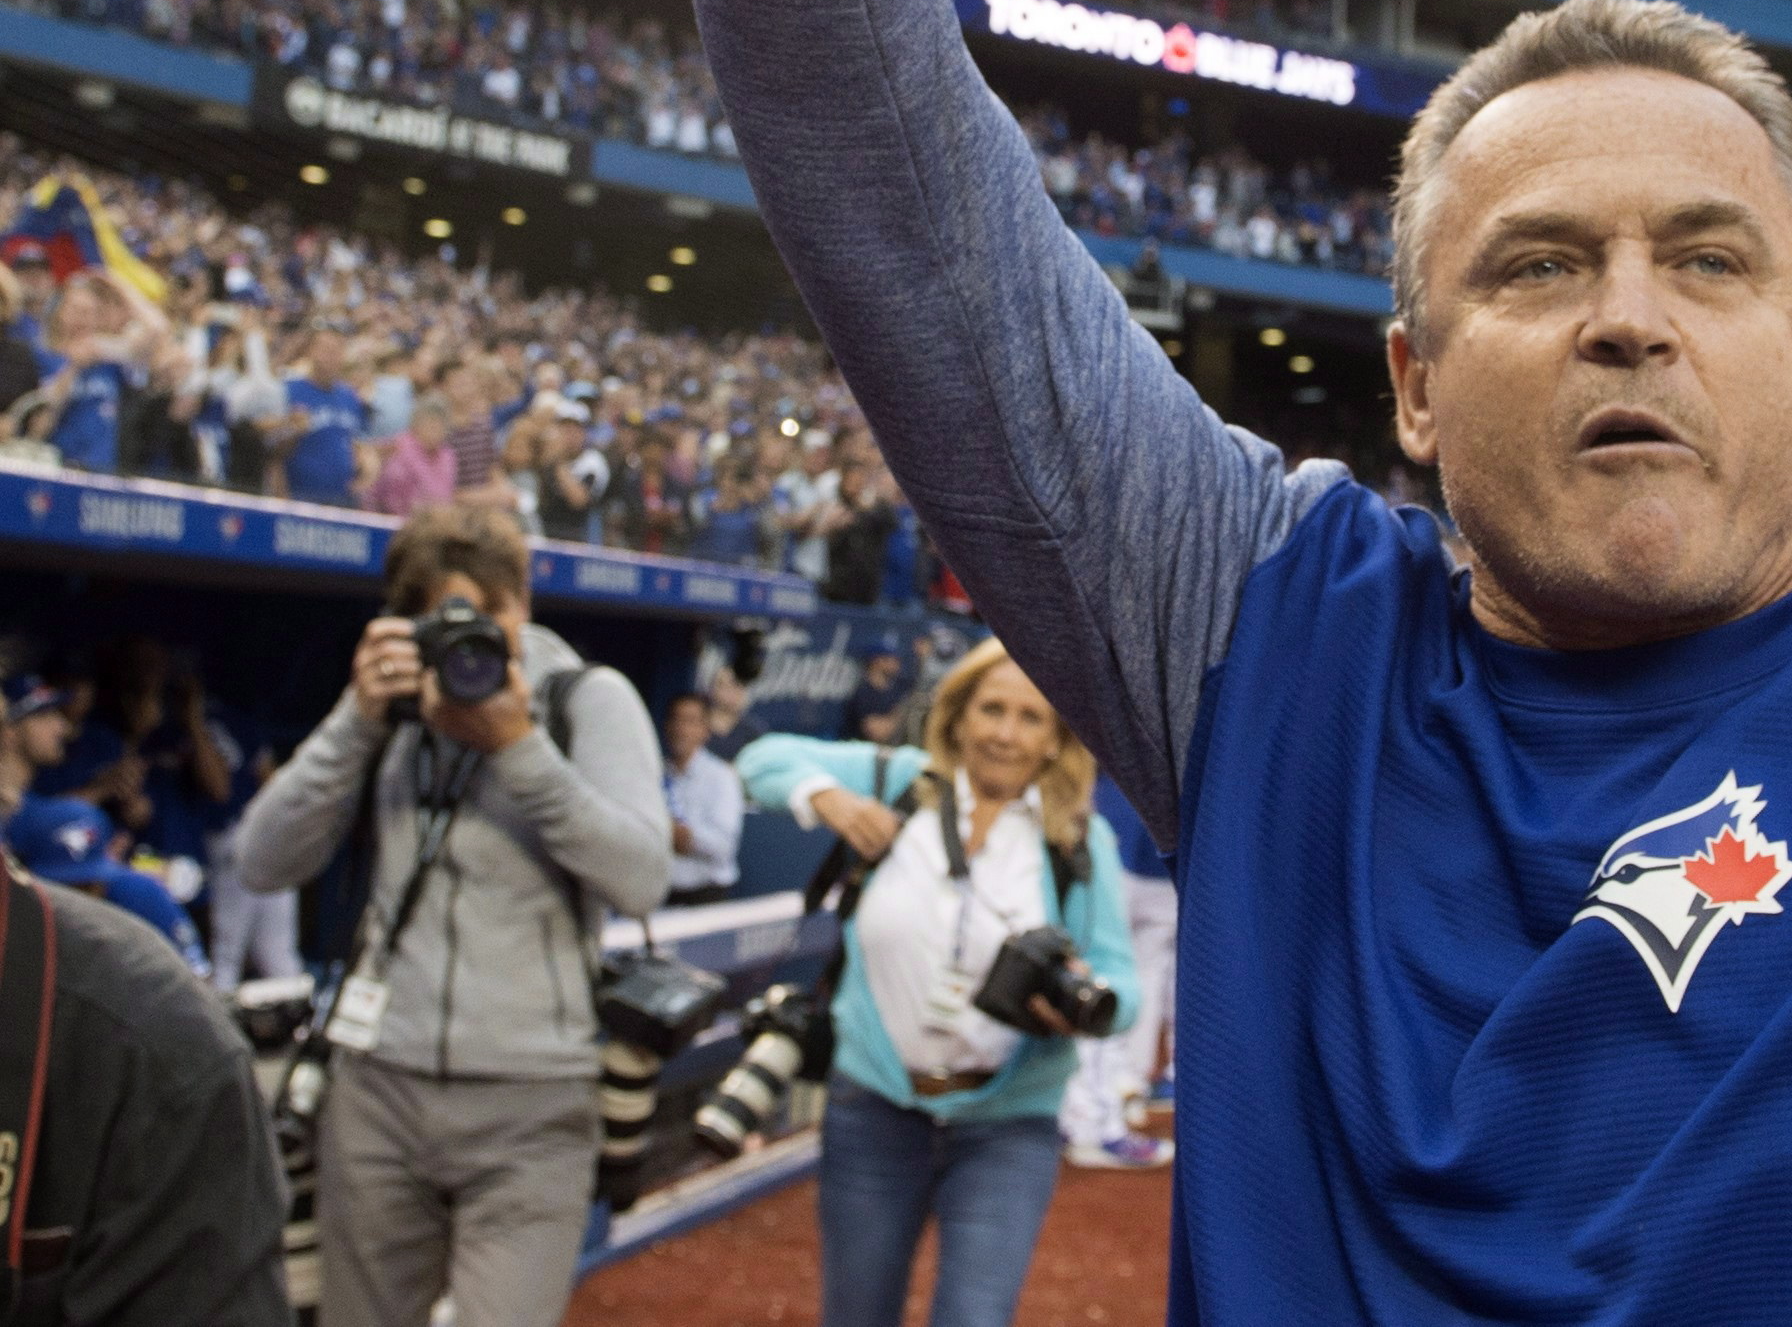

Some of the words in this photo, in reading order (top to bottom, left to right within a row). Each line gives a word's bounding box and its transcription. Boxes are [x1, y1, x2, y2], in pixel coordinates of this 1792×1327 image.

[1195, 31, 1278, 91] BLUE
[1274, 51, 1355, 106] JAYS
[274, 517, 371, 566] SAMSUNG
